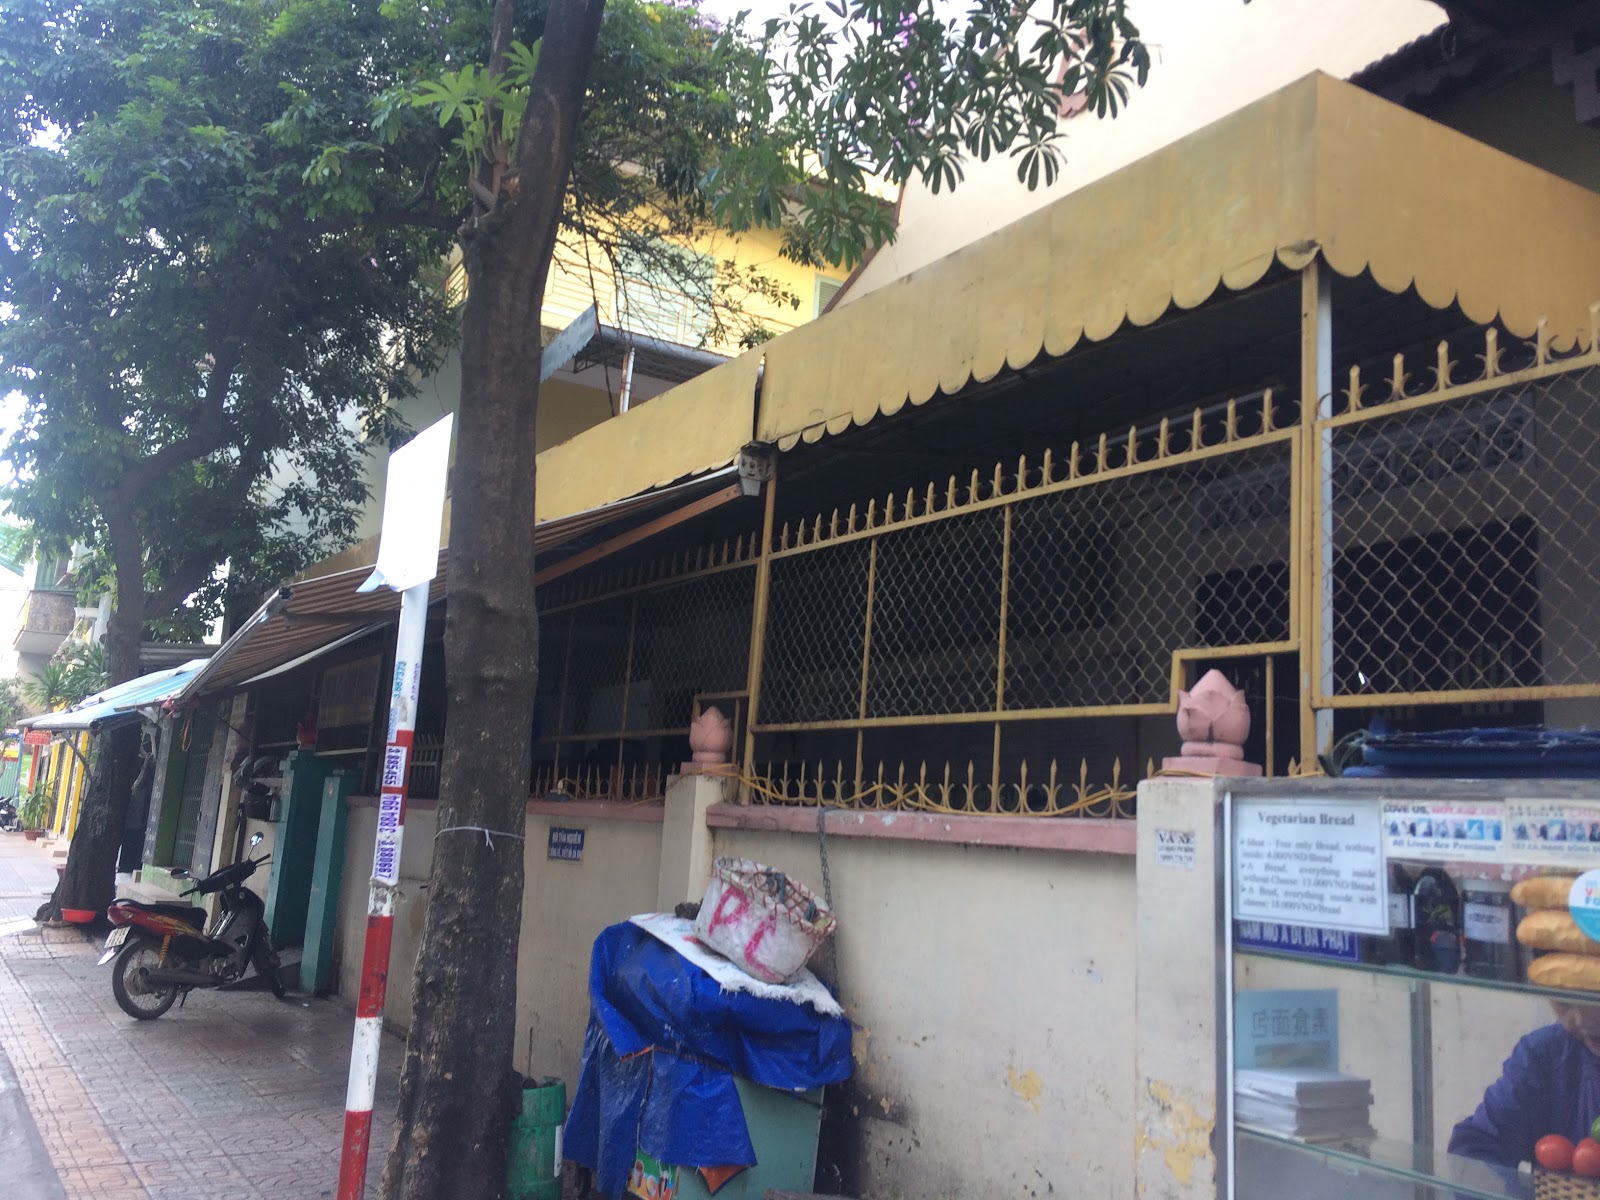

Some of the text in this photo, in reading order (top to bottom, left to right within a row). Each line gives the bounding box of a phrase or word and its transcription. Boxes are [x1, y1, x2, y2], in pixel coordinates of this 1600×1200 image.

[1257, 811, 1355, 827] Vegetarian Bread
[1345, 842, 1376, 854] nothing
[1407, 840, 1431, 848] Lives
[1453, 843, 1496, 851] Precious
[1298, 867, 1341, 878] everything
[1283, 890, 1324, 902] everything
[1359, 895, 1378, 905] with
